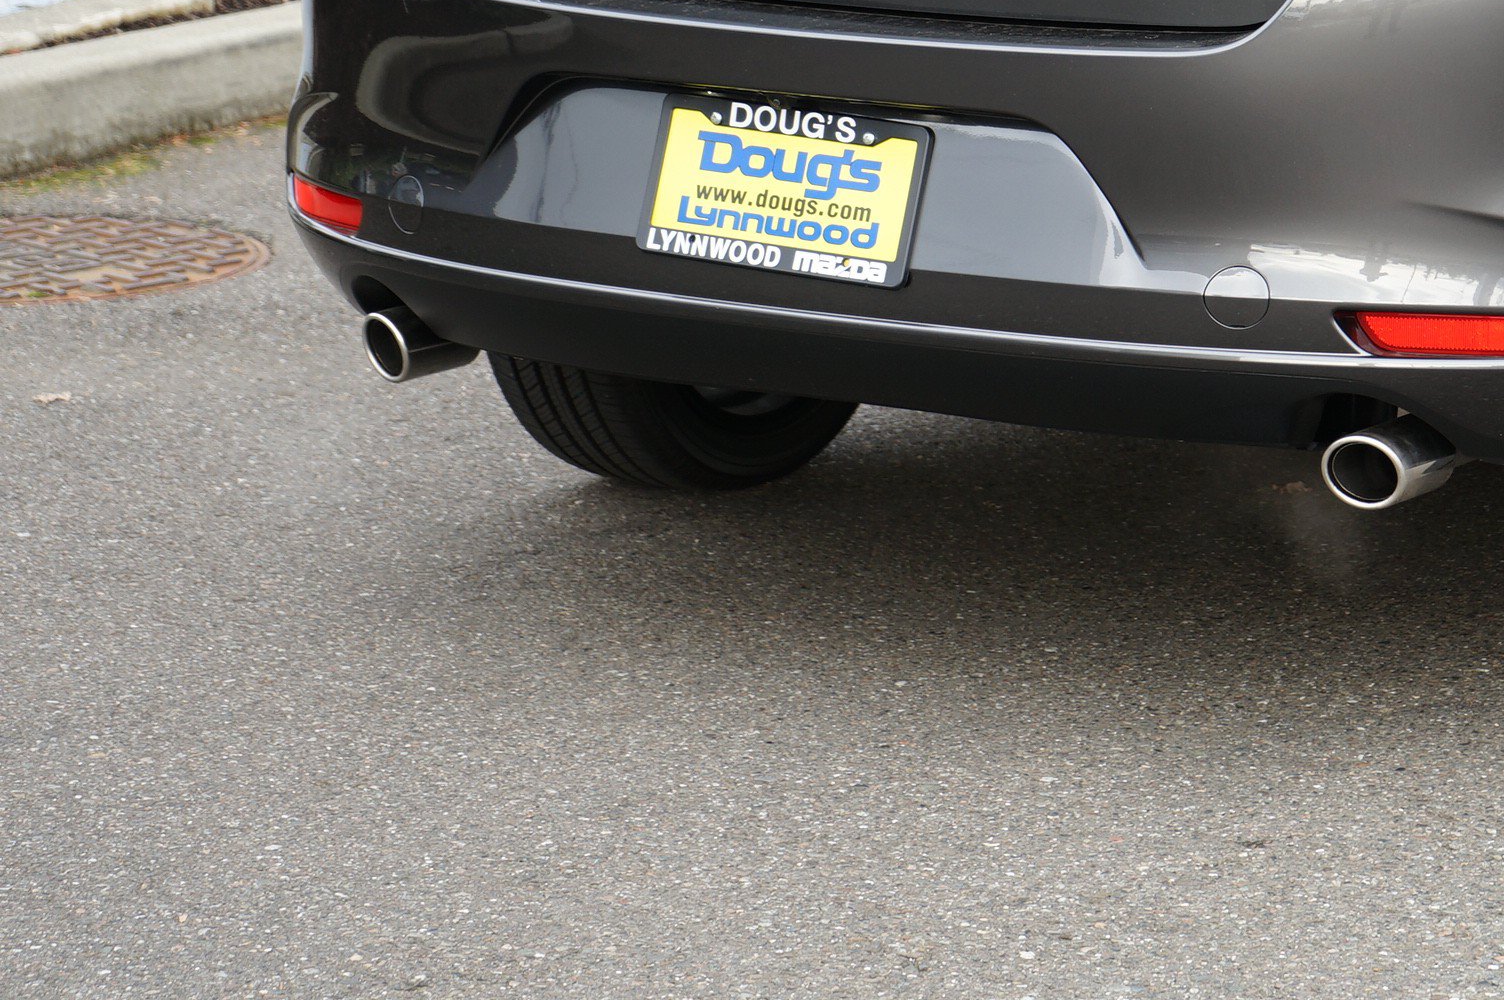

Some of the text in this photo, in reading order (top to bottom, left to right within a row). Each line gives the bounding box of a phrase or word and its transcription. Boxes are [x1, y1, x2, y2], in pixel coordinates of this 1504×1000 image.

[729, 101, 857, 143] DOUG'S
[698, 130, 882, 200] Doug's
[677, 195, 880, 249] Lynnwood
[696, 184, 872, 222] www.dougs.com
[646, 227, 781, 268] LYNNWOOD
